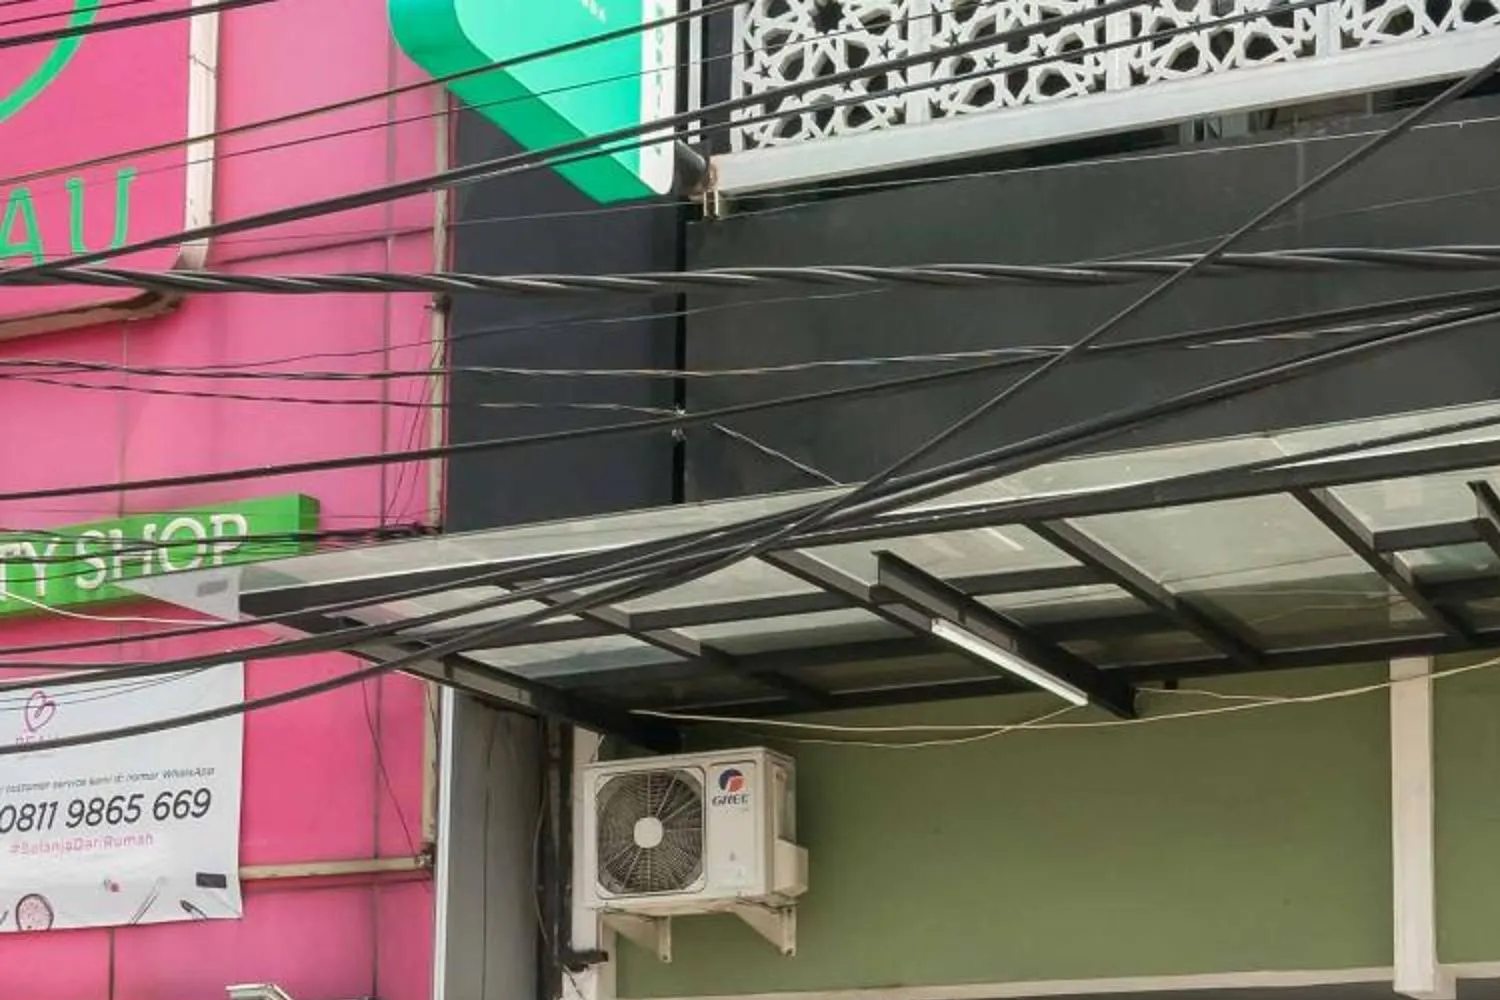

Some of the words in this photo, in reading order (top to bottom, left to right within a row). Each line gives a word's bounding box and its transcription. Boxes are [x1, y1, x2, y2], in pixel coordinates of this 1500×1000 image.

[75, 513, 249, 591] SHOP
[0, 801, 58, 834] 0811
[65, 793, 145, 829] 9865
[152, 787, 213, 821] 669
